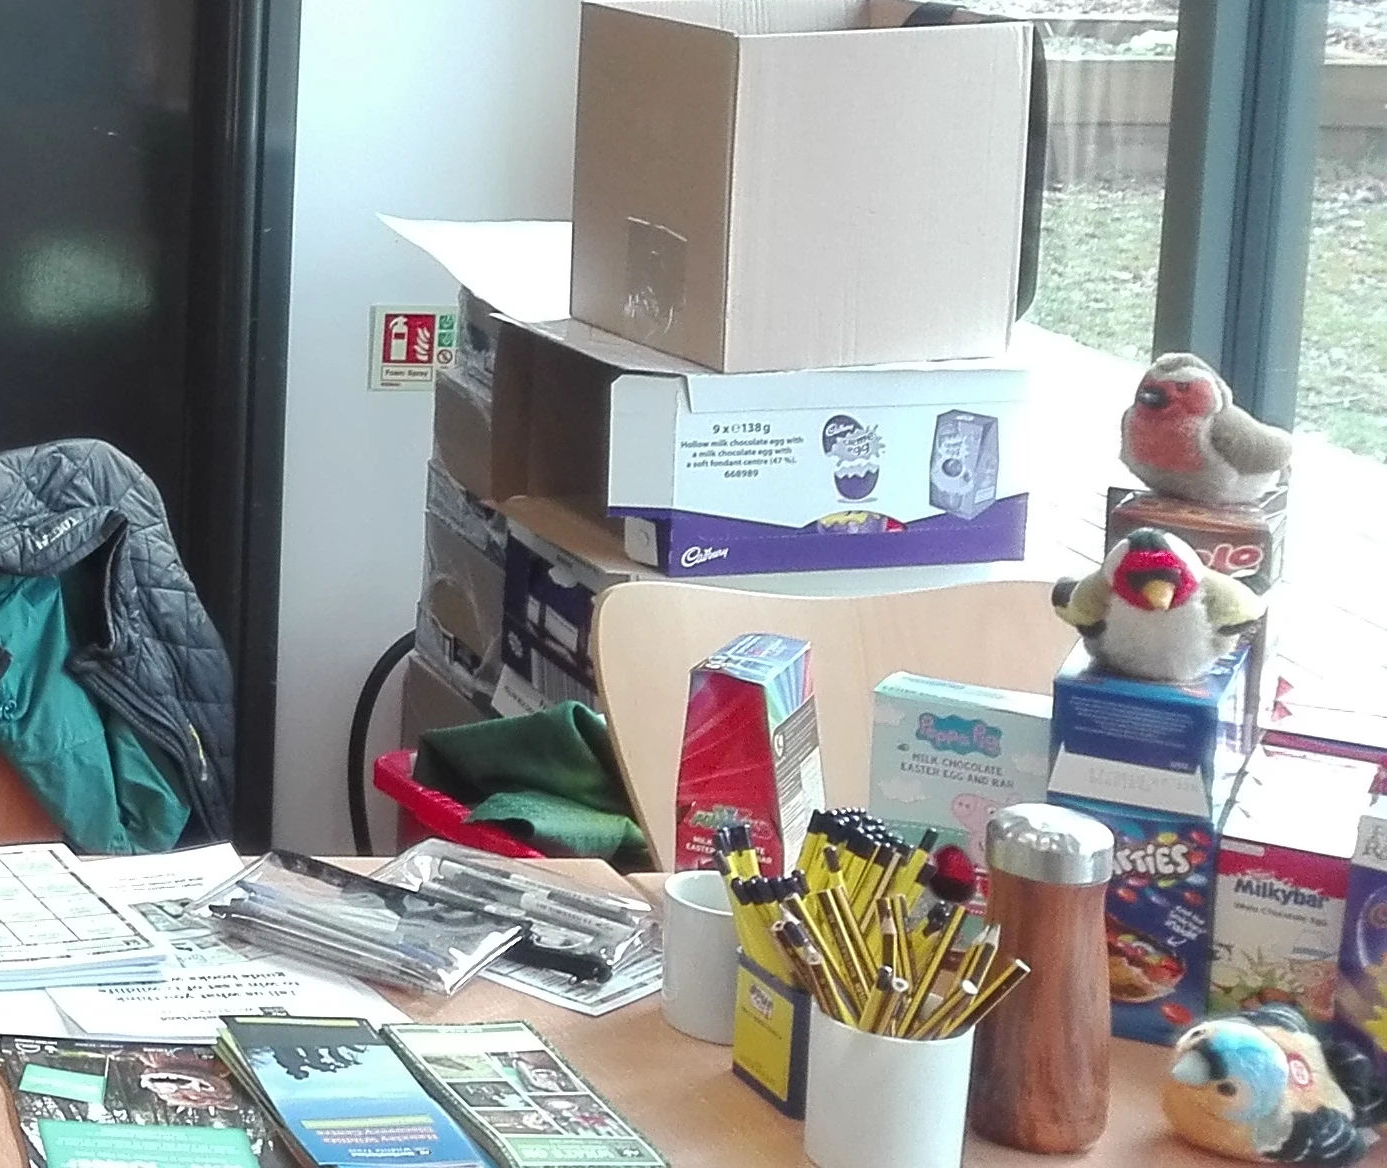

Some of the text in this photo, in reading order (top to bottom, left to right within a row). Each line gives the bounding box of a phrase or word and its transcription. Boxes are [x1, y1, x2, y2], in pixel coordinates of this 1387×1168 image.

[712, 424, 720, 434] 9
[729, 438, 768, 447] chocolate
[770, 438, 785, 446] egg
[787, 436, 804, 444] with
[718, 449, 756, 457] chocolate
[758, 449, 773, 457] egg
[693, 460, 709, 468] soft
[710, 459, 742, 467] fondant
[724, 470, 759, 478] 668989
[912, 753, 1003, 776] MILK CHOCOLATE
[900, 762, 1014, 788] EASTER EGG AND BAR
[1234, 878, 1330, 909] Milkybar
